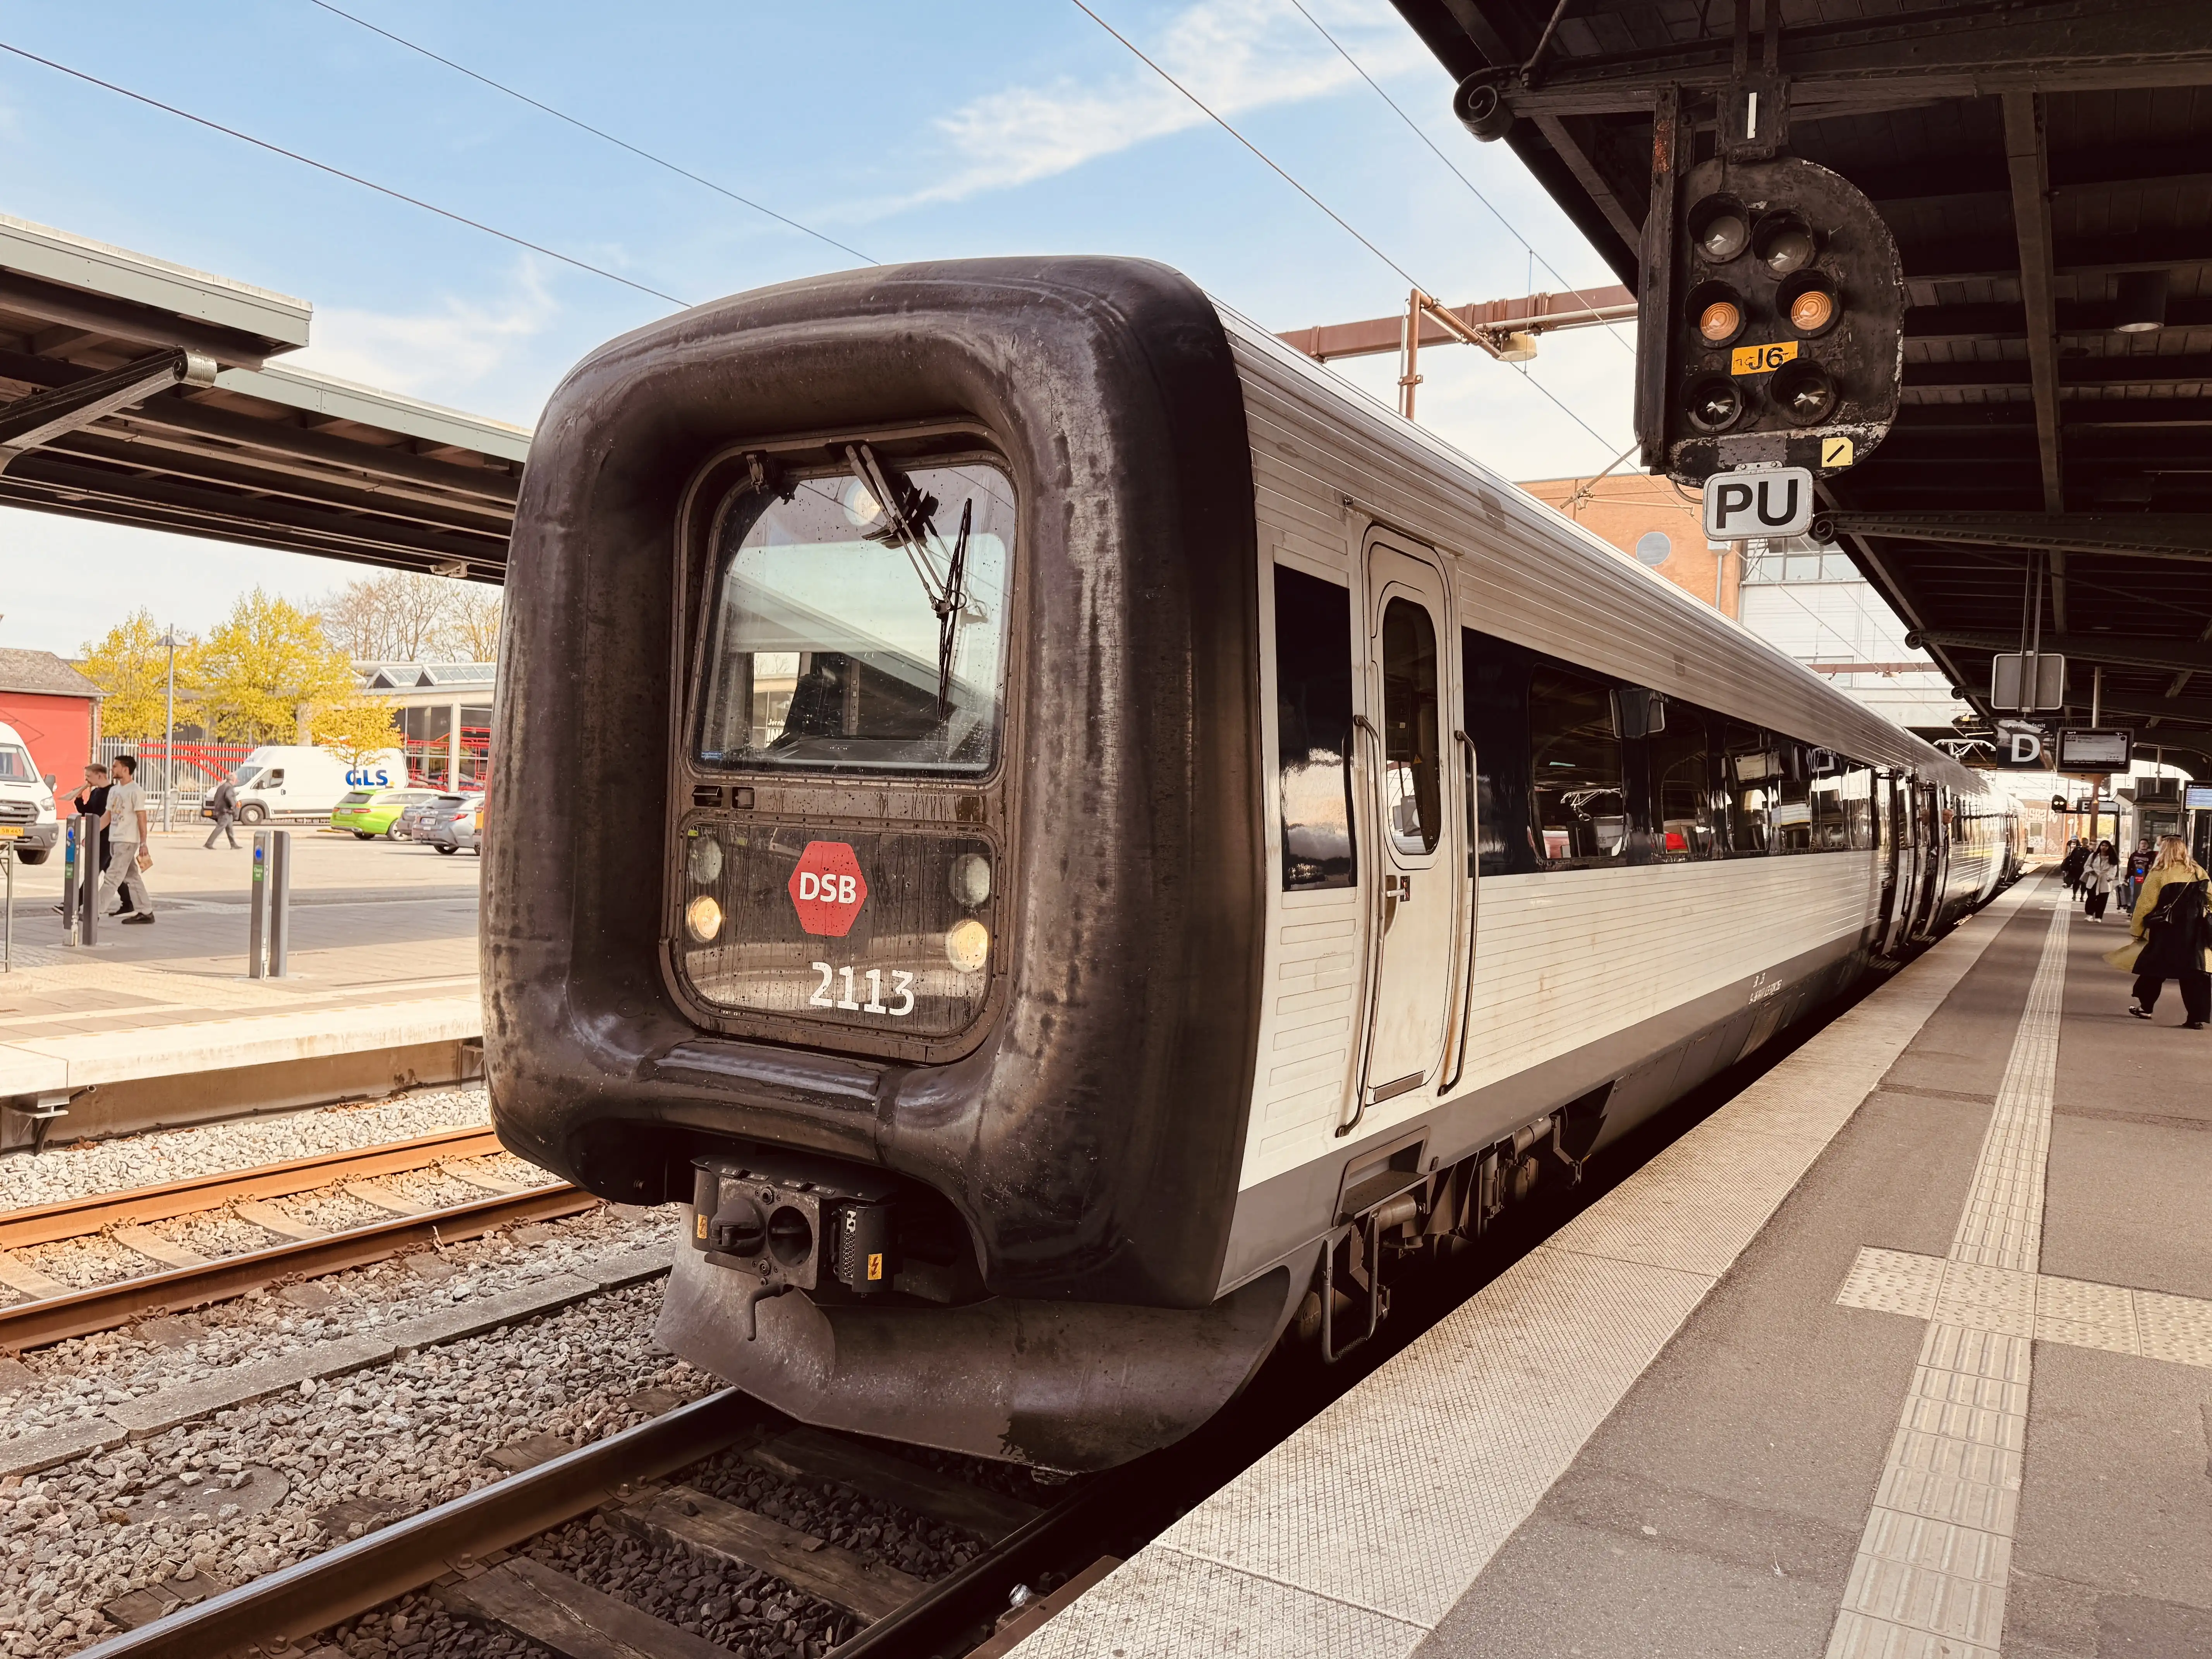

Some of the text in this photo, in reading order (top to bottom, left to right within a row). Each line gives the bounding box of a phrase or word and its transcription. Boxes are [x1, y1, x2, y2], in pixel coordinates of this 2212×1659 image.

[1748, 347, 1784, 370] J6
[1716, 479, 1798, 529] PU
[2011, 733, 2040, 762] D
[345, 769, 388, 786] GLS
[2081, 801, 2090, 811] E
[799, 872, 857, 904] DSB
[809, 962, 915, 1016] 2113
